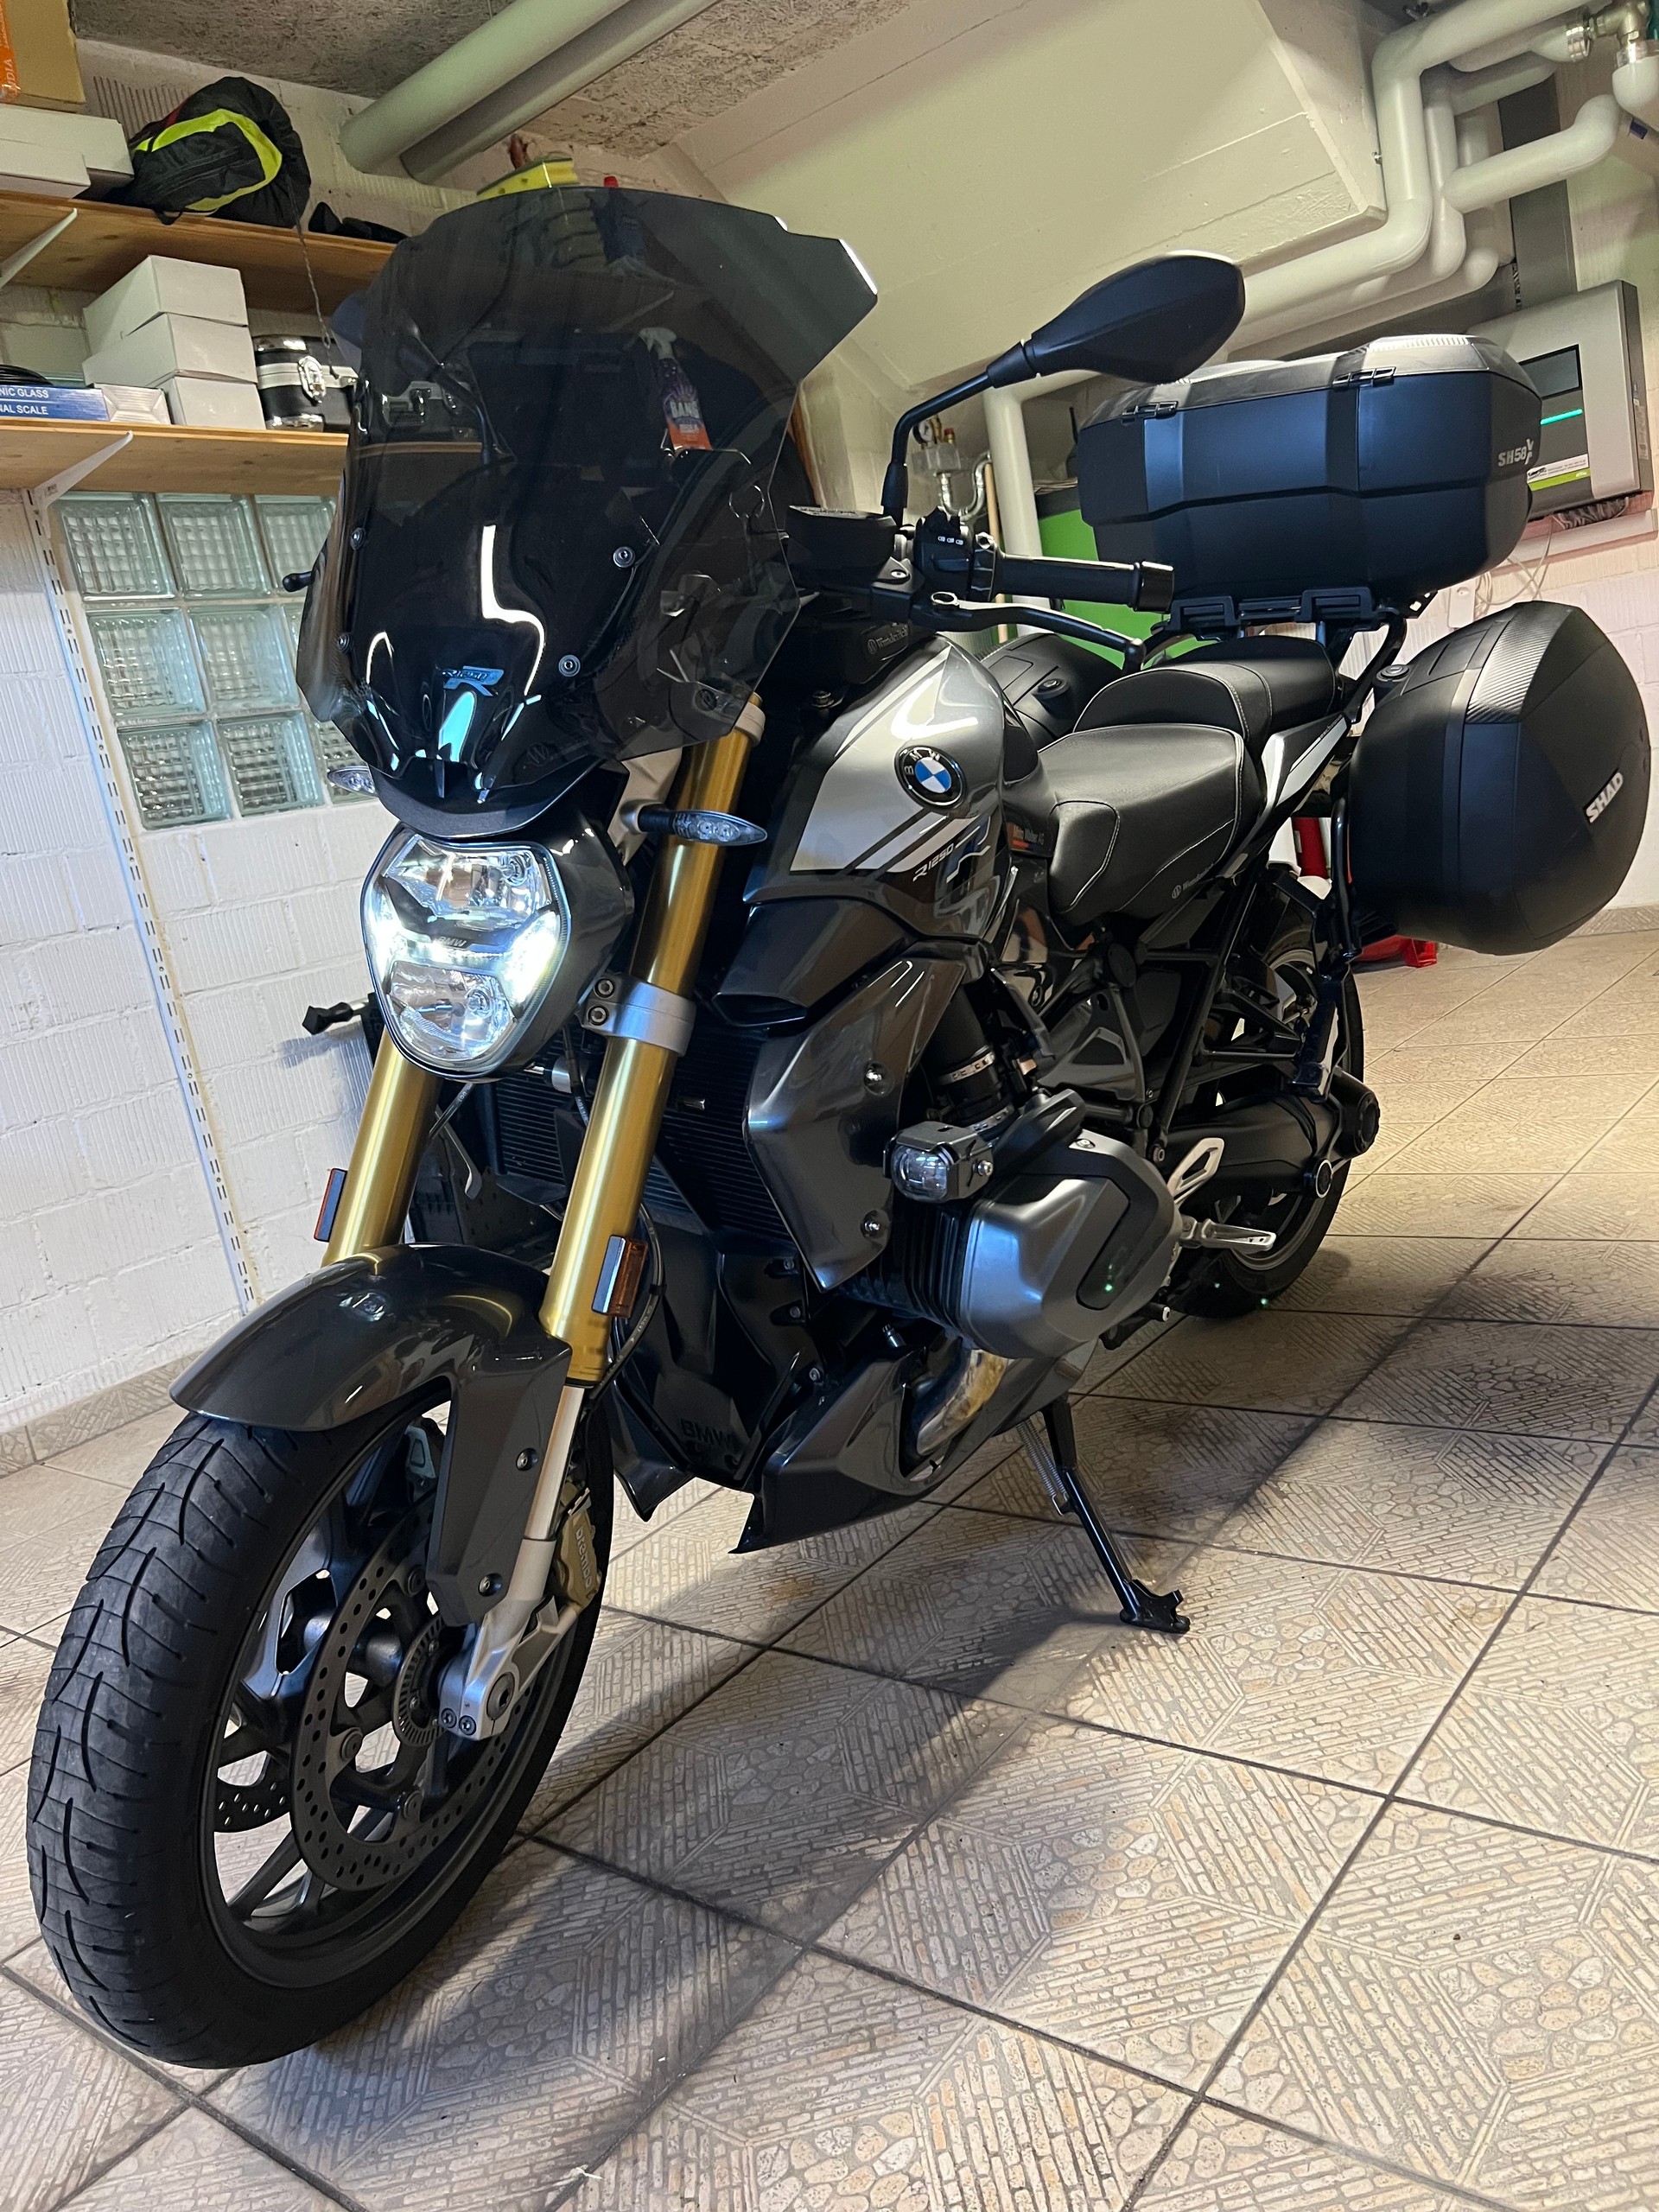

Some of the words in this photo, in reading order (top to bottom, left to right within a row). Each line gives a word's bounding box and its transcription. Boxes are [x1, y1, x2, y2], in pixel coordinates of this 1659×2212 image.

[17, 388, 49, 398] GLASS
[16, 405, 49, 415] SCALE
[904, 747, 941, 775] BMW
[1586, 772, 1624, 823] SHAD
[912, 842, 954, 882] R1250
[438, 936, 467, 947] BMW
